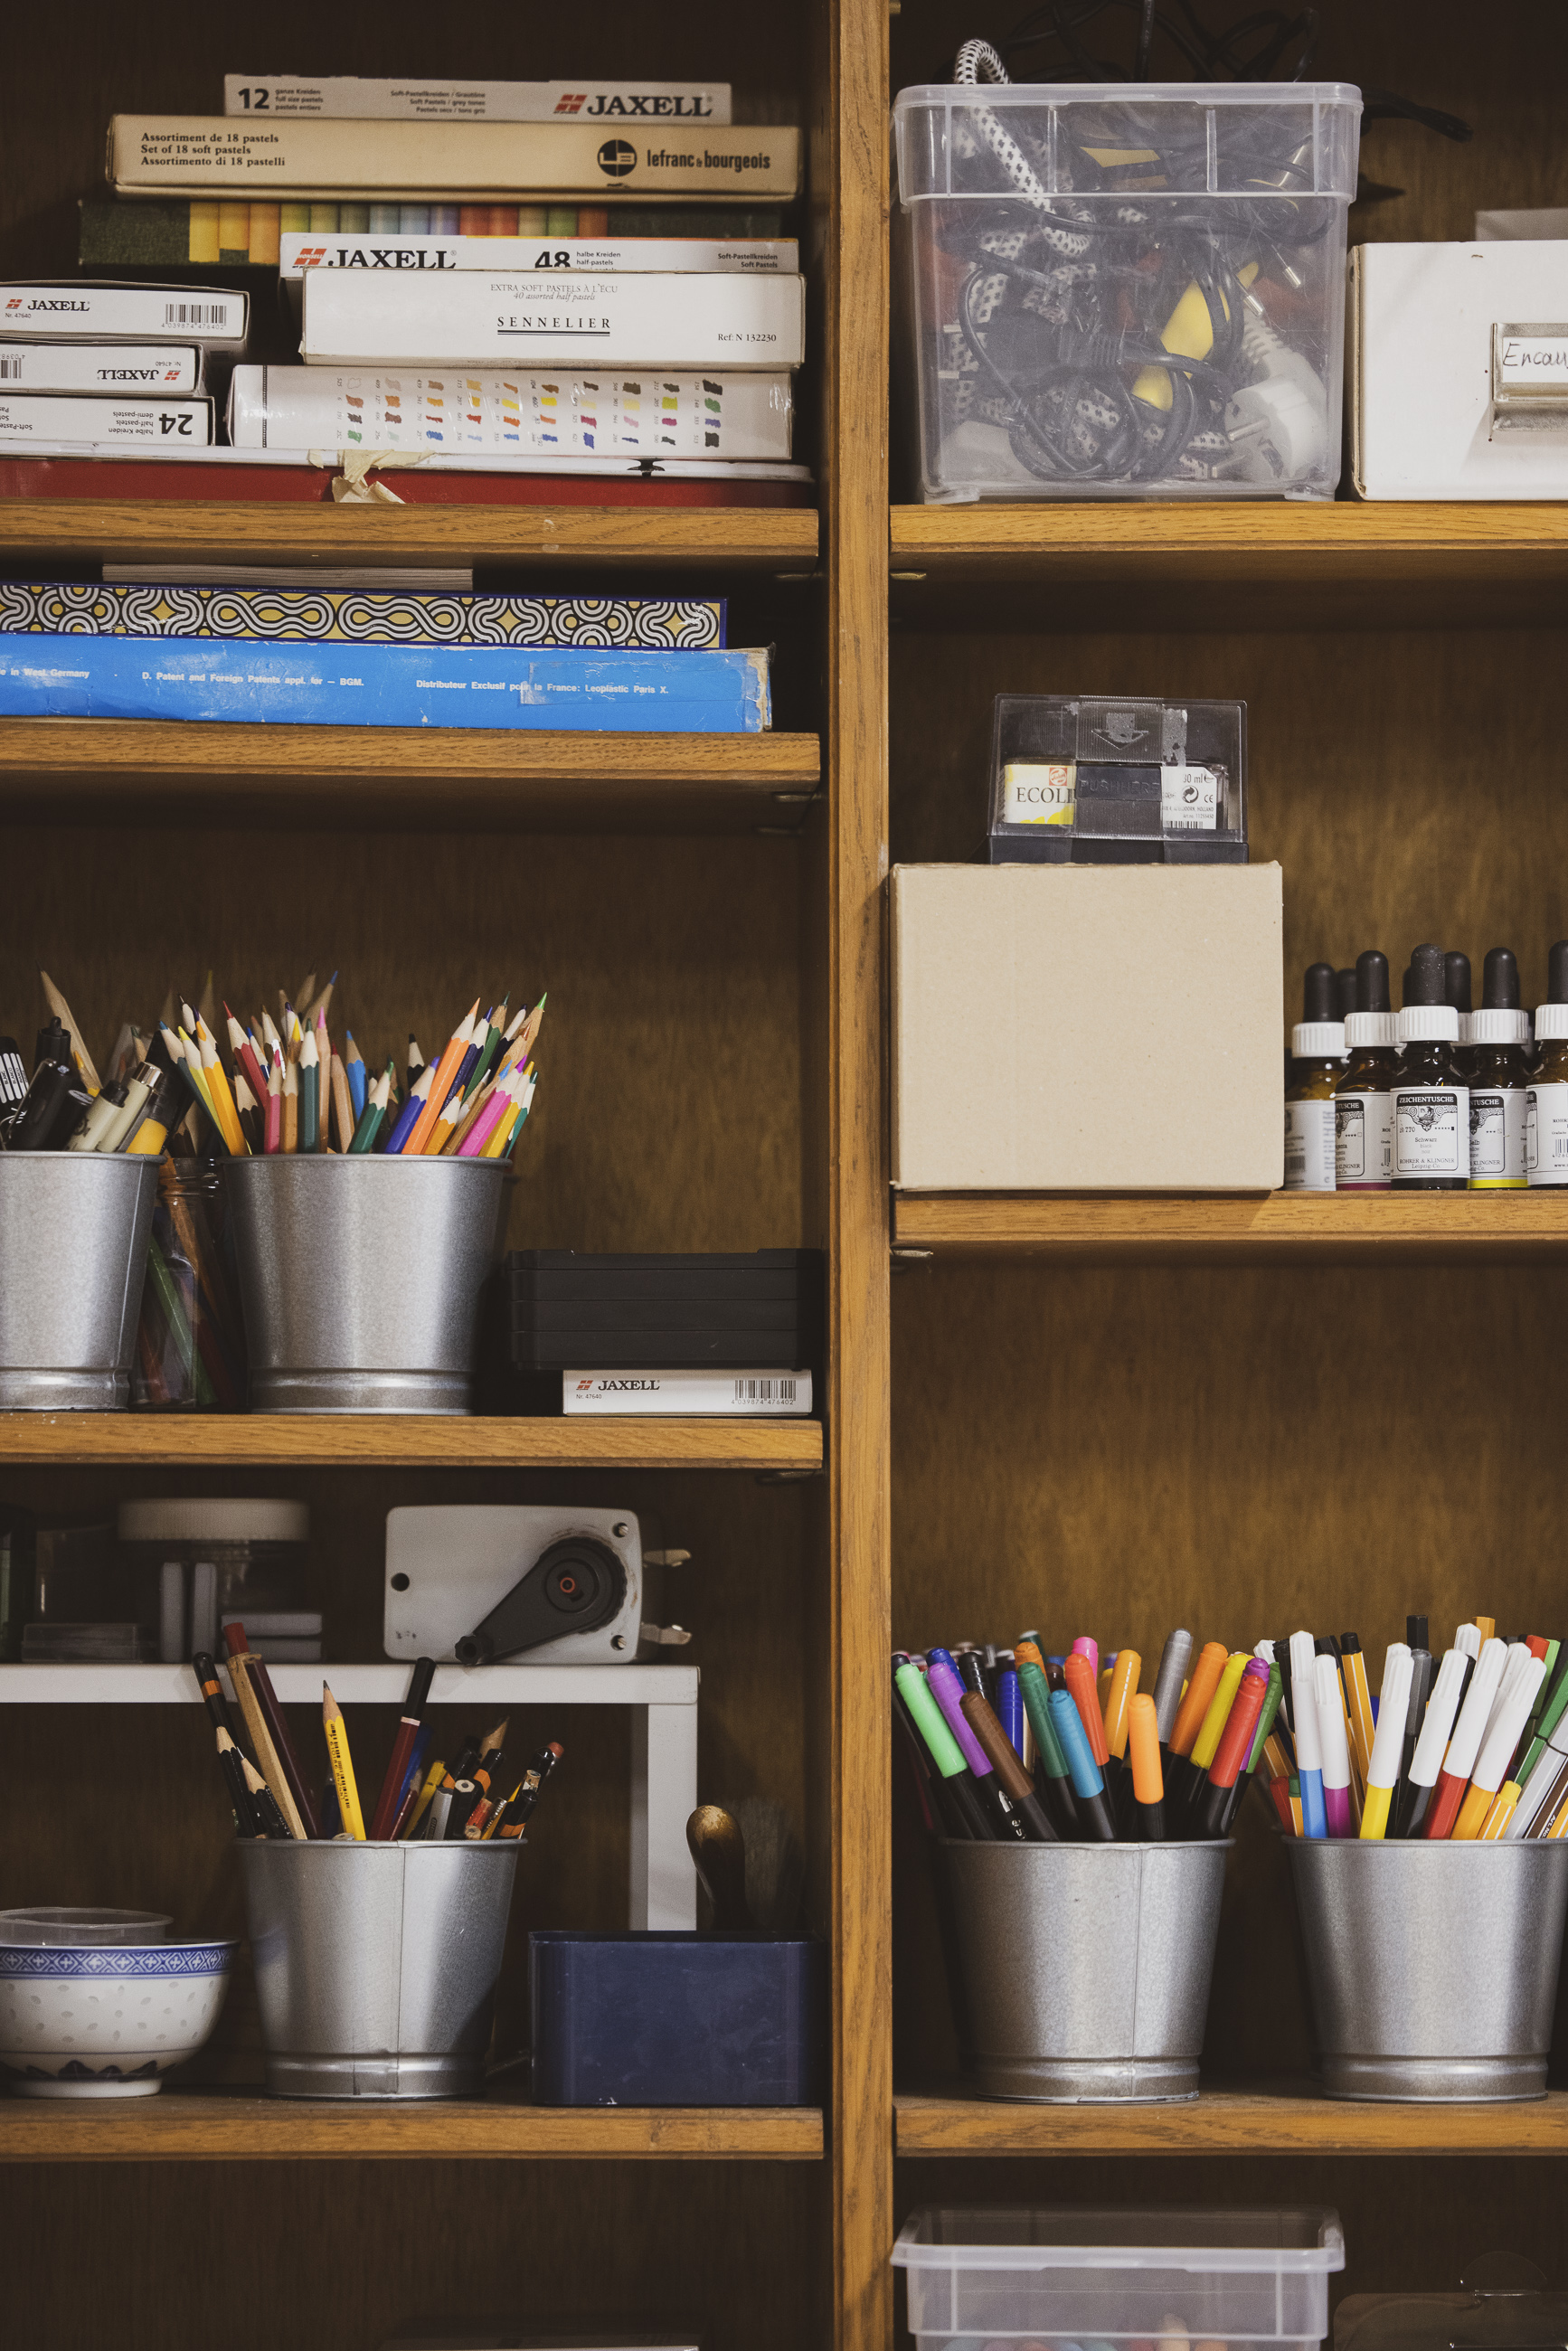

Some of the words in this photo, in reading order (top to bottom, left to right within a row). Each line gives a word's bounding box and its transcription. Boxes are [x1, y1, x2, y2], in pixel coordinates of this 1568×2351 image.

[238, 88, 269, 109] 12
[142, 133, 205, 142] Assortiment
[210, 134, 222, 142] de
[243, 134, 279, 144] pastels
[141, 144, 157, 153] Set
[161, 145, 172, 153] of
[177, 145, 188, 153] 18
[192, 145, 211, 153] soft
[215, 146, 251, 156] pastels
[141, 156, 211, 165] Assortimento
[247, 157, 285, 167] pastelli
[534, 251, 570, 268] 48
[522, 284, 543, 292] SOFT
[546, 284, 581, 293] PASTELS
[583, 283, 589, 293] À
[513, 292, 524, 300] 40
[525, 292, 554, 300] assorted
[556, 292, 571, 302] half
[572, 293, 596, 302] pastels
[497, 317, 610, 328] SENNELIER
[746, 334, 777, 343] 132230
[159, 414, 193, 435] 24
[50, 669, 90, 679] Germany
[142, 671, 153, 680] D.
[156, 672, 185, 681] Patent
[189, 673, 206, 682] and
[210, 673, 244, 685] Foreign
[248, 674, 281, 685] Patents
[285, 675, 306, 686] appl.
[311, 676, 324, 685] for
[340, 677, 365, 686] BGM.
[416, 679, 467, 690] Distributeur
[471, 680, 506, 690] Exclusif
[510, 683, 529, 693] pour
[534, 683, 542, 692] la
[547, 683, 581, 692] France:
[585, 684, 629, 695] Leoplastic
[633, 685, 655, 694] Paris
[660, 686, 669, 694] X.
[1183, 774, 1191, 783] 30
[1194, 774, 1203, 783] ml
[1548, 1815, 1556, 1827] Art
